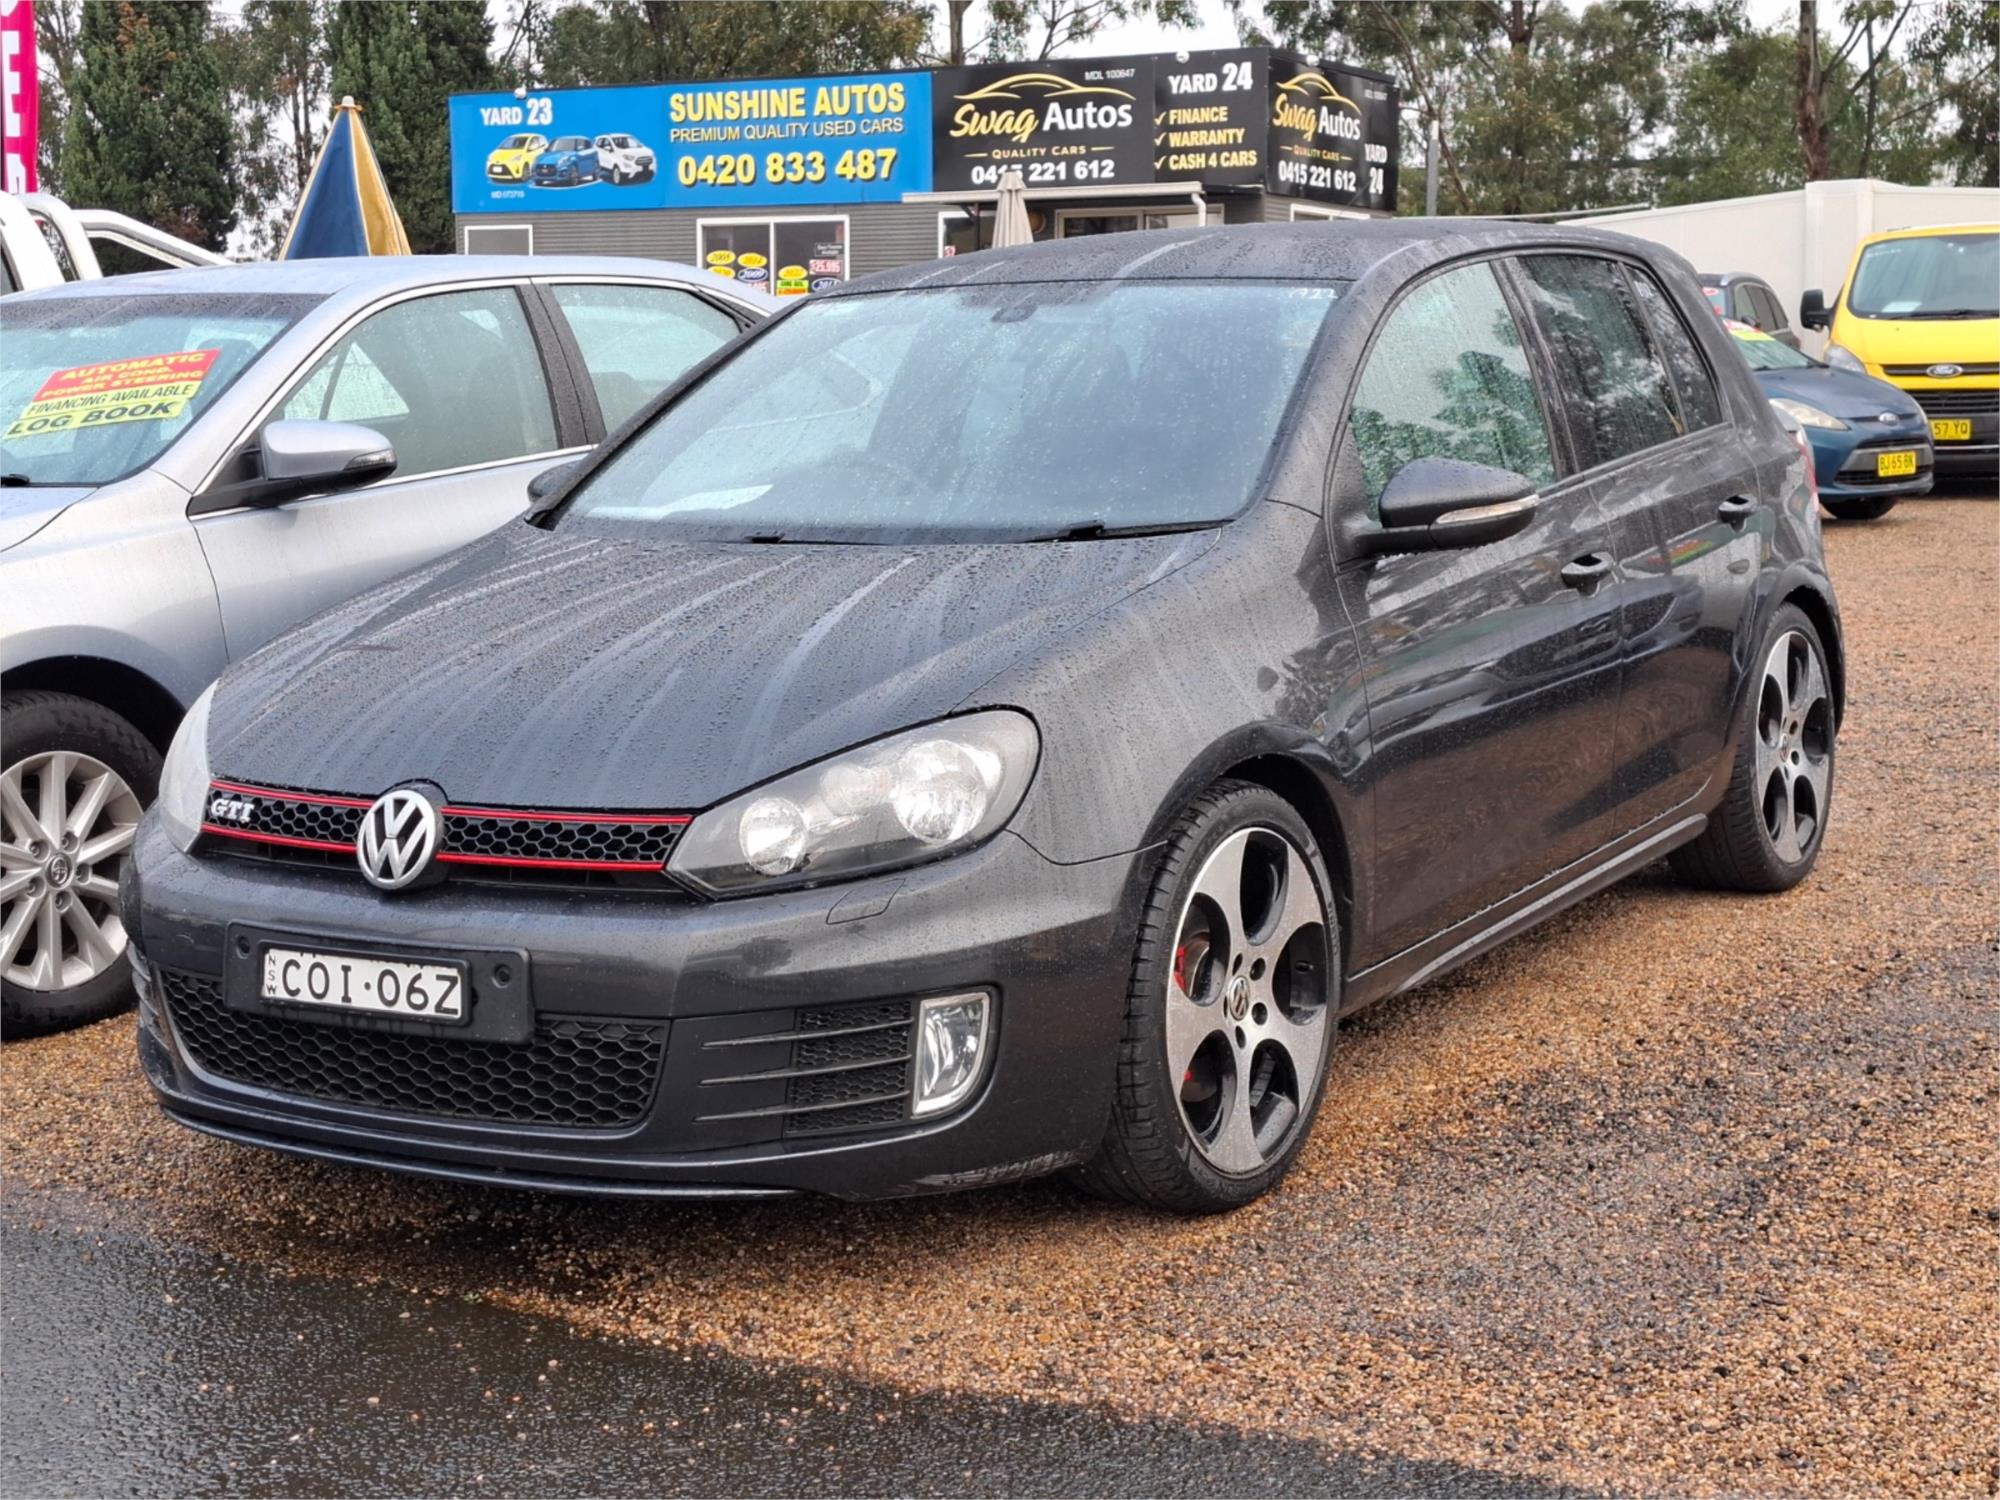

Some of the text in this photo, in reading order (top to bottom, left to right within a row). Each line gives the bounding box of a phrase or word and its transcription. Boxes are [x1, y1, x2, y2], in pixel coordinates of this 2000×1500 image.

[1168, 61, 1253, 94] YARD 24
[480, 97, 553, 126] YARD 23
[670, 82, 905, 122] SUNSHINE AUTOS
[1169, 106, 1228, 125] FINANCE
[670, 117, 904, 143] PREMIUM QUALITY USED CARS
[950, 101, 1133, 143] Swag Autos
[1272, 93, 1361, 141] Swag Autos
[1168, 128, 1245, 147] WARRANTY
[992, 145, 1086, 159] QUALITY CARS
[1169, 150, 1258, 170] CASH 4 CARS
[1293, 145, 1340, 161] QUALITY CARS
[1364, 144, 1387, 163] YARD
[678, 148, 897, 186] 0420 833 487
[1028, 161, 1067, 182] 221
[1074, 159, 1115, 180] 612
[1278, 160, 1356, 192] 0415 221 612
[1369, 167, 1384, 194] 24
[61, 352, 206, 381] AUTOMATIC
[81, 374, 114, 384] AIR
[41, 370, 205, 398] POWER STEERING
[28, 383, 195, 415] FINANCING AVAILABLE
[7, 400, 178, 435] LOG BOOK
[210, 798, 255, 823] GTI
